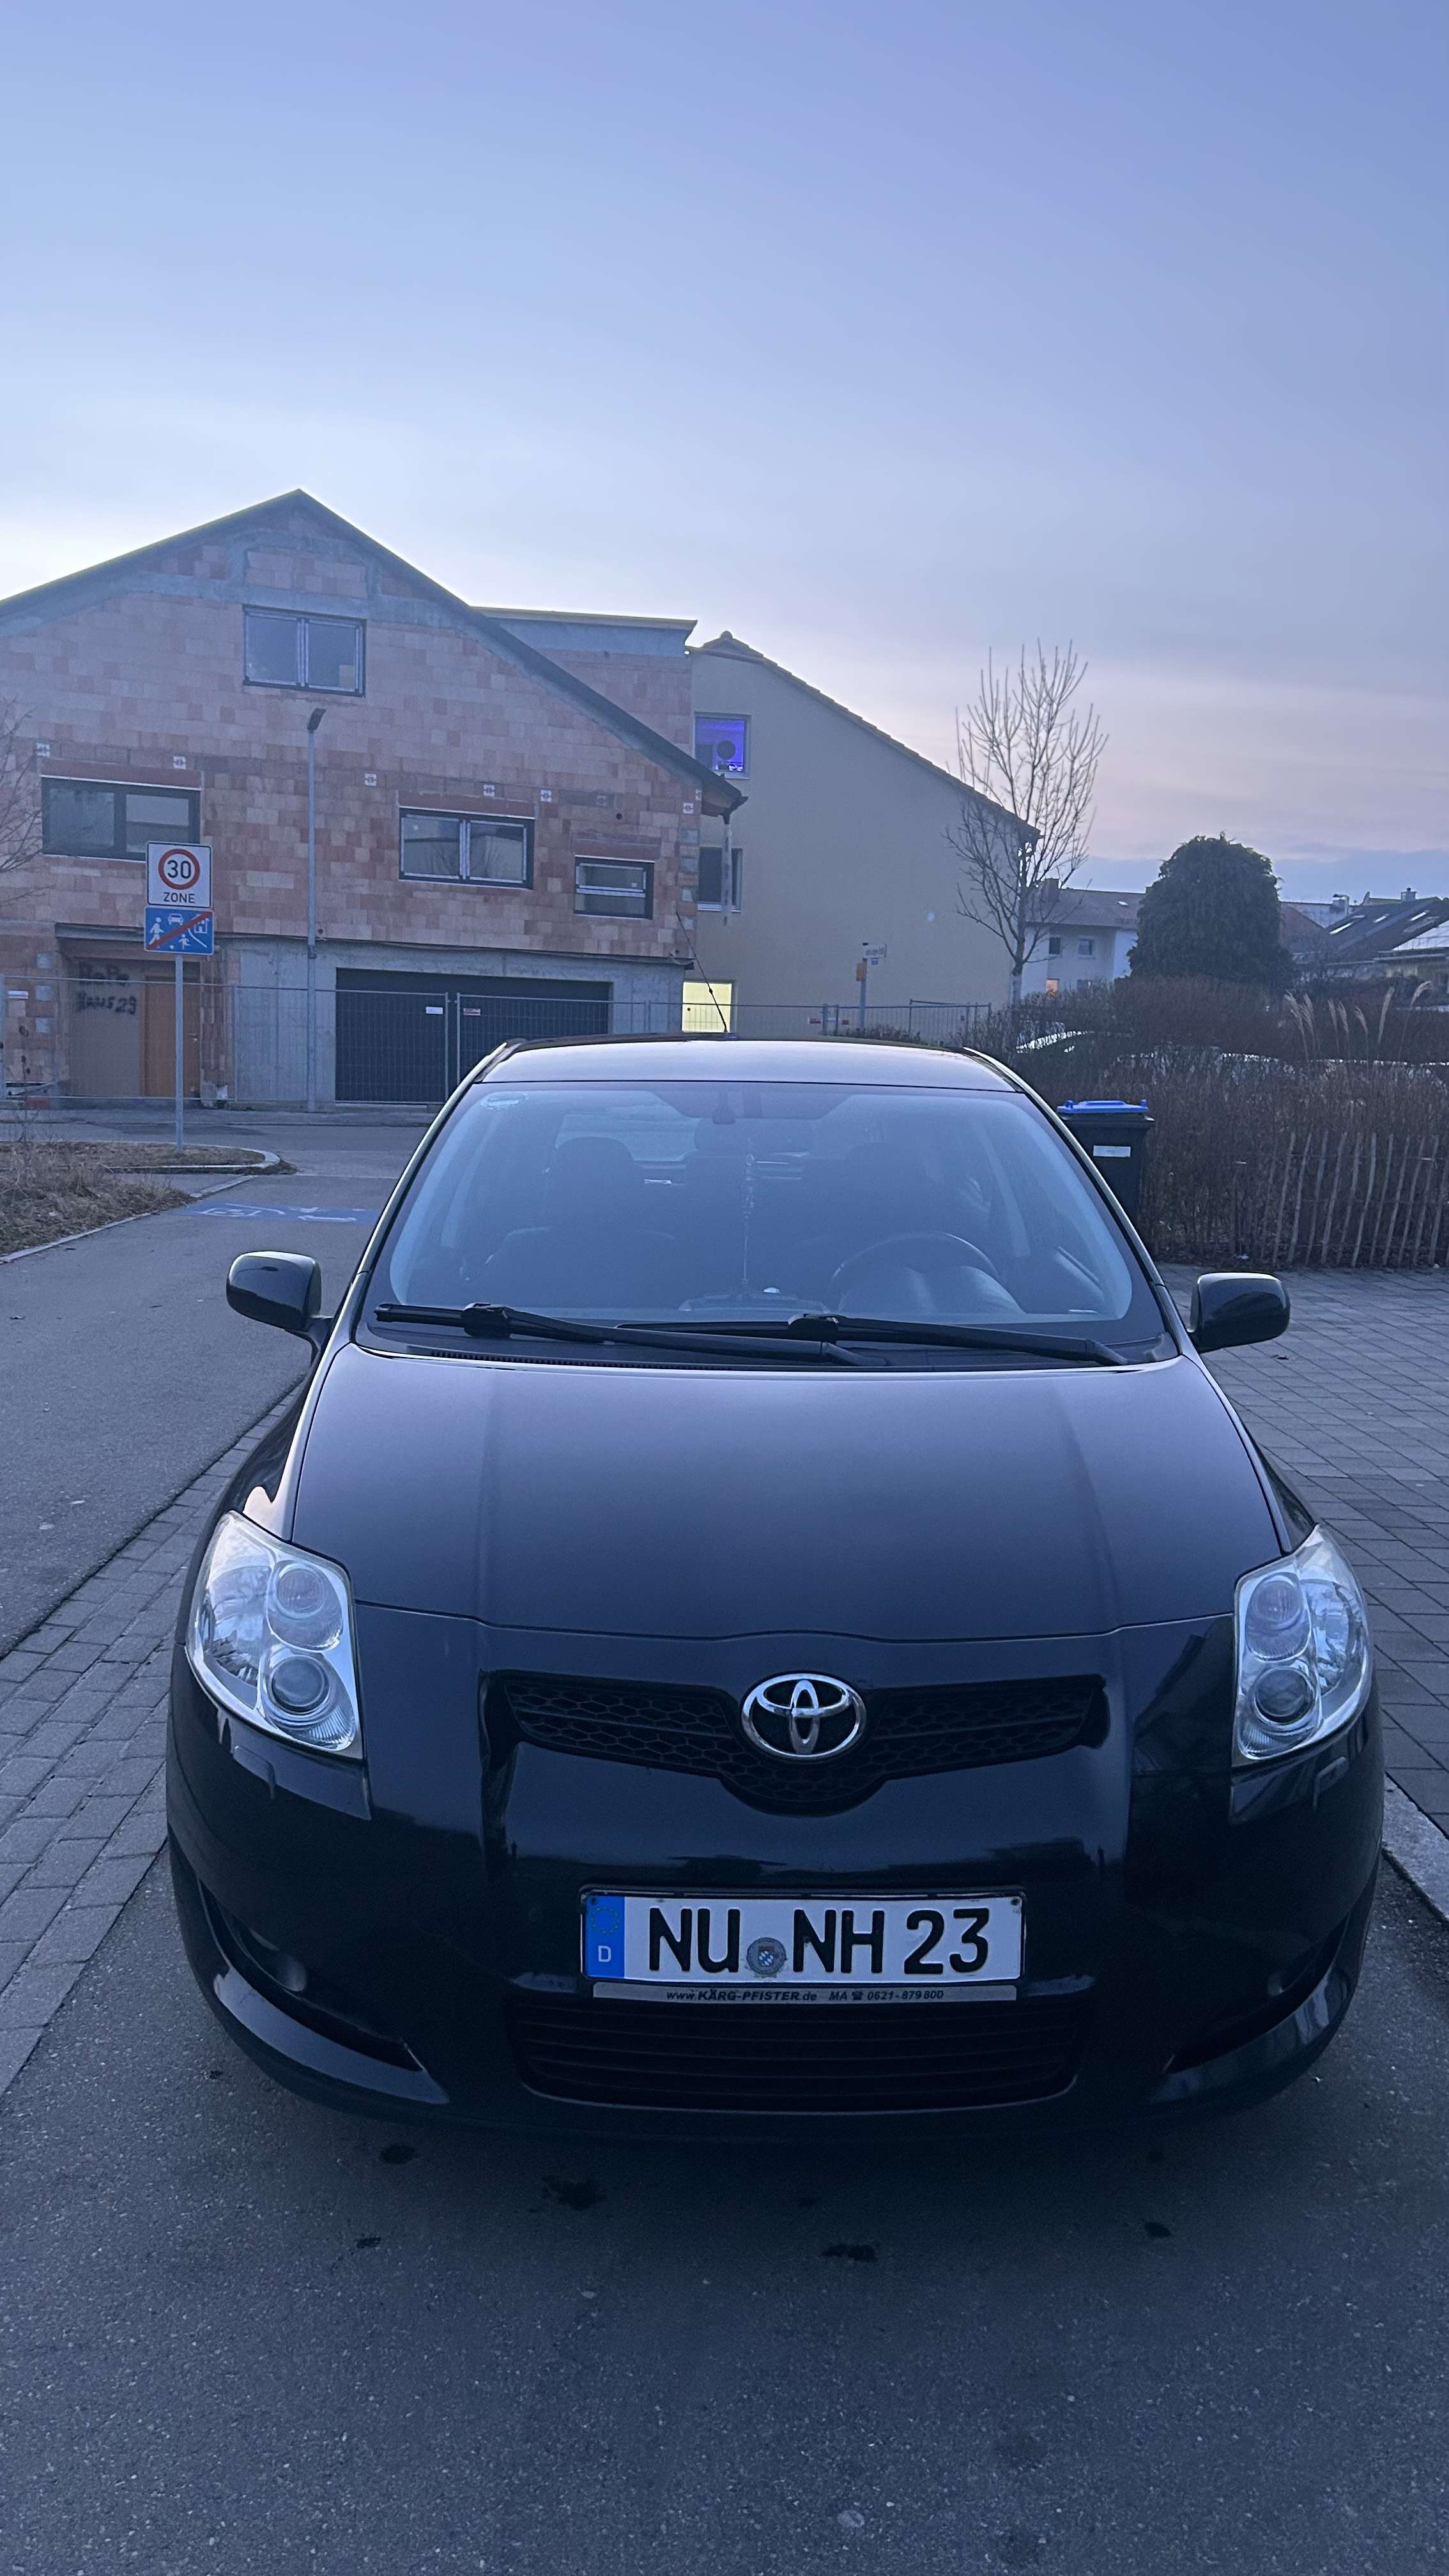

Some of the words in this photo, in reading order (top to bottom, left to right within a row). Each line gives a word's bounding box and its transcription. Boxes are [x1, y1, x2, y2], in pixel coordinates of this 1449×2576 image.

[167, 860, 191, 878] 30
[163, 891, 195, 903] ZONE
[648, 1907, 740, 1972] NU
[793, 1909, 885, 1973] NH
[903, 1908, 990, 1975] 23
[597, 1945, 611, 1962] D
[829, 1991, 848, 2000] MA
